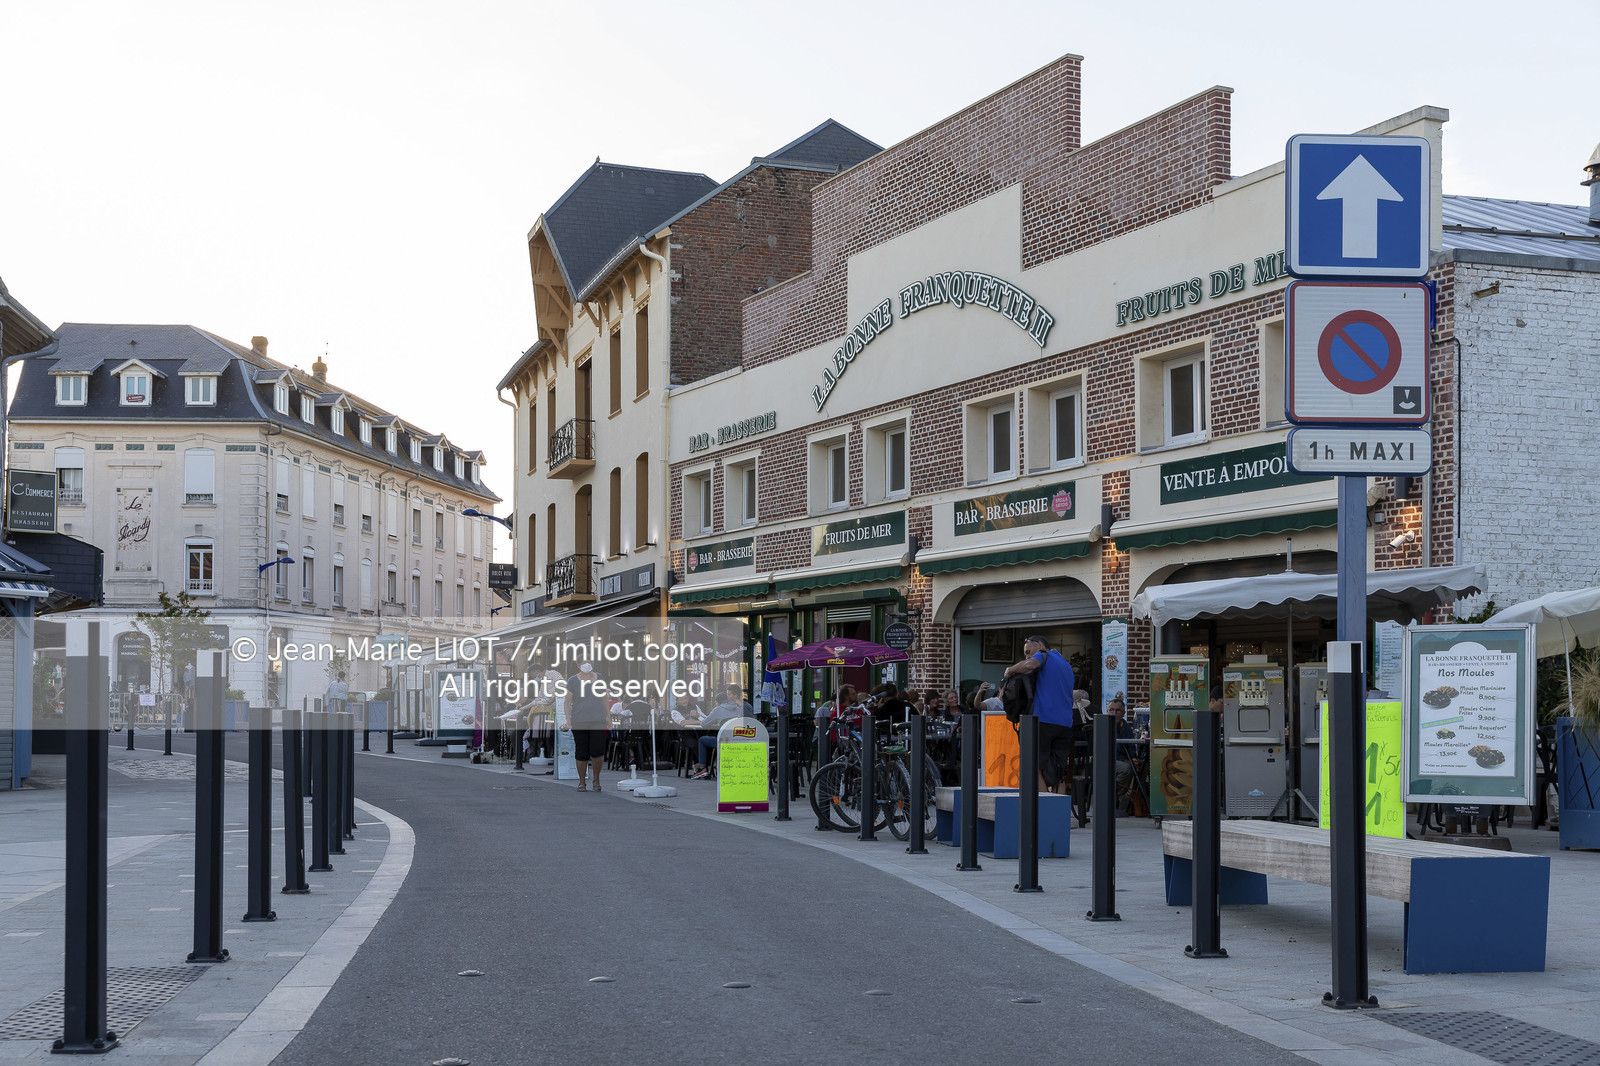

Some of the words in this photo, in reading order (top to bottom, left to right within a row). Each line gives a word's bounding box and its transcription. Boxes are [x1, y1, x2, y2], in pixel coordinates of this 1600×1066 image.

[1115, 276, 1202, 328] FRUITS
[1208, 261, 1246, 300] DE
[1252, 249, 1286, 287] ME
[811, 367, 837, 413] LA
[832, 298, 893, 379] BONNE
[899, 270, 1037, 331] FRANQUETTE
[1028, 304, 1056, 349] II
[688, 431, 709, 453] BAR
[717, 410, 777, 445] BRASSERIE
[1350, 441, 1415, 461] MAXI
[1163, 468, 1217, 492] VENTE
[1218, 465, 1231, 484] A
[25, 487, 54, 498] COMMERCE
[124, 495, 144, 511] Le
[956, 508, 979, 526] BAR
[986, 497, 1049, 521] BRASSERIE
[825, 529, 856, 546] FRUITS
[856, 526, 870, 541] DE
[871, 523, 892, 539] MER
[699, 552, 713, 565] BAR
[716, 545, 753, 562] BRASSERIE
[1437, 668, 1456, 677] Nos
[1458, 668, 1495, 677] Moules
